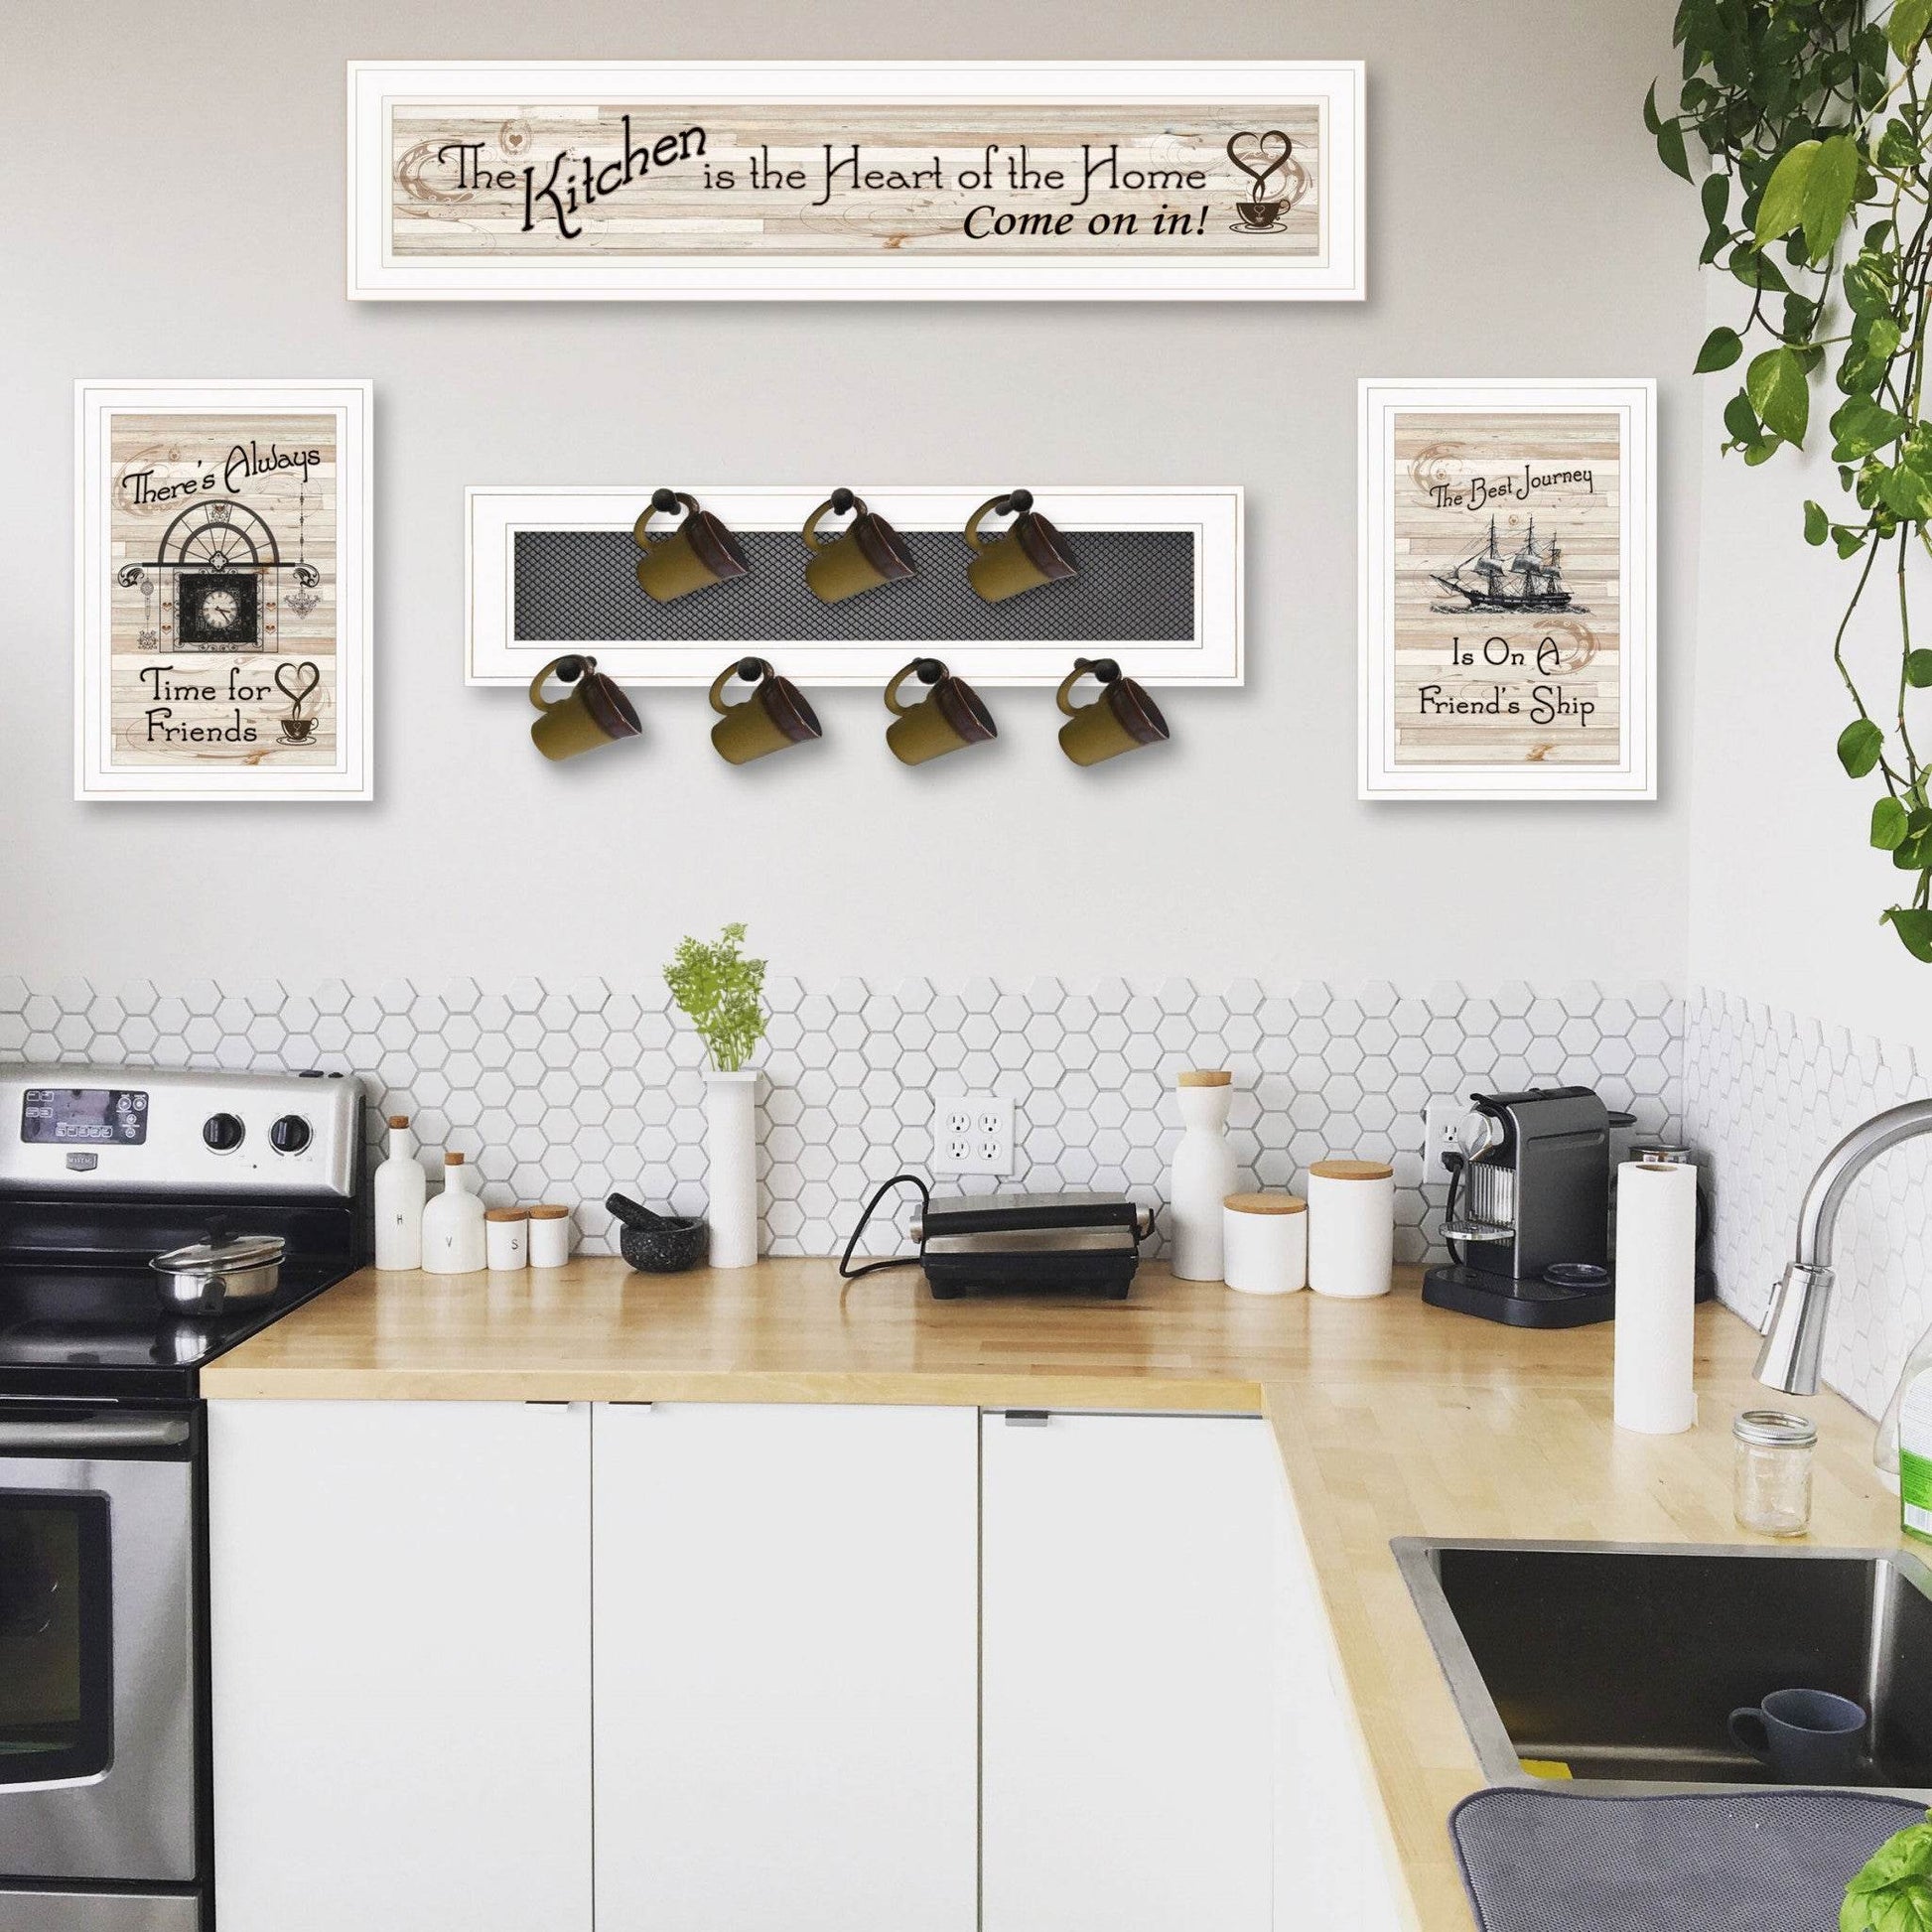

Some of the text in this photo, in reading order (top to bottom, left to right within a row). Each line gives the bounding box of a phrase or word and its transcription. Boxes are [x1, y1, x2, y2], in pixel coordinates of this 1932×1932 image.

[438, 114, 1206, 239] The Kitchen is the Heart of the Home
[963, 204, 1209, 239] Come on in!
[121, 440, 322, 504] There's Always
[1429, 465, 1593, 511] The Best Journey
[1452, 635, 1560, 676] Is On A
[139, 665, 272, 702] Time for
[144, 707, 258, 743] Friends
[1418, 685, 1595, 728] Friend's Ship
[396, 1213, 404, 1226] H
[446, 1236, 453, 1248] V
[510, 1238, 519, 1250] S
